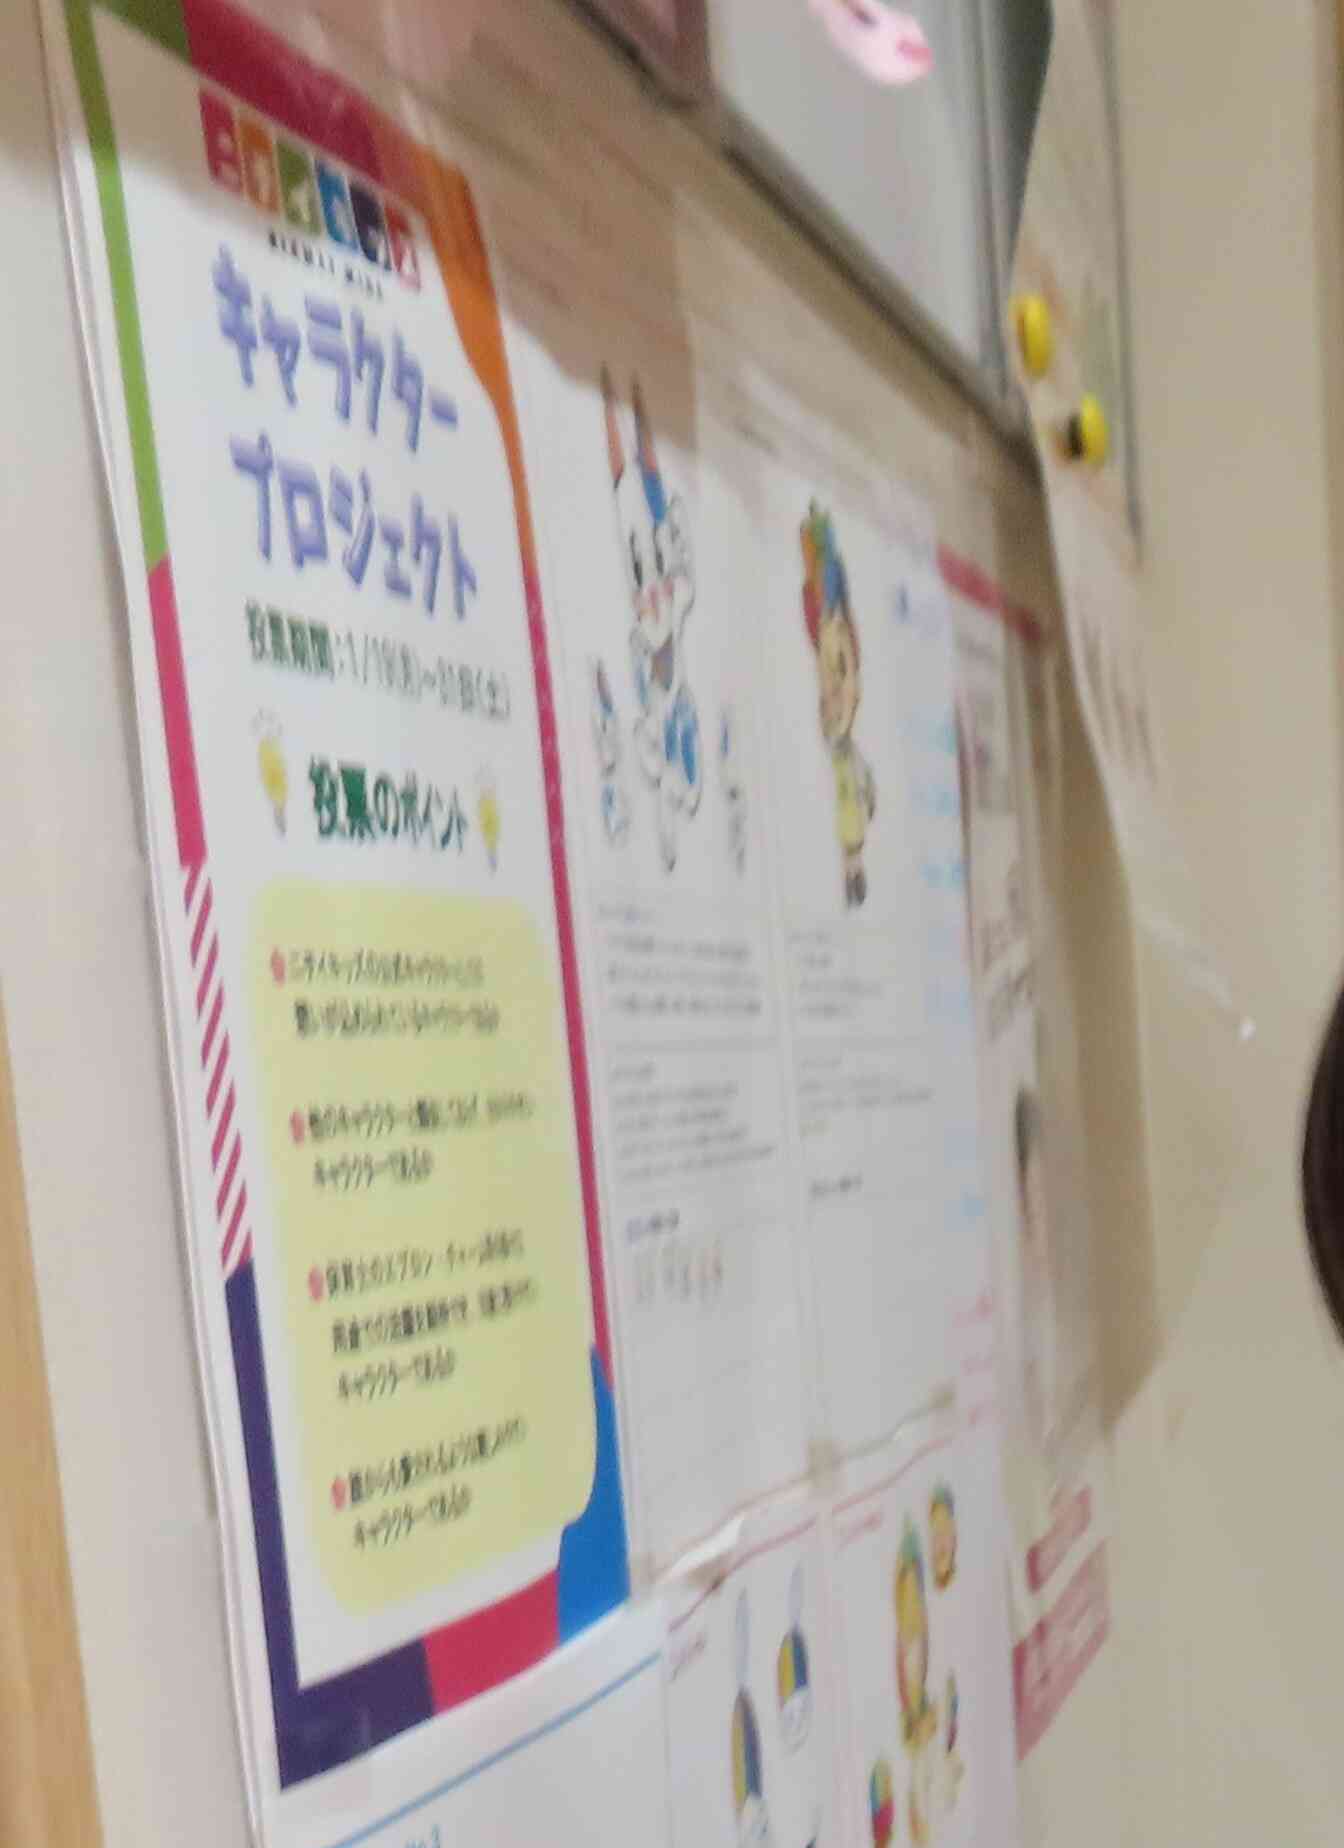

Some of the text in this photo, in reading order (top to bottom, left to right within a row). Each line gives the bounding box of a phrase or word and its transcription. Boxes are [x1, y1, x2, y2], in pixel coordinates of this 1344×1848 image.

[211, 242, 459, 453] キャラクター
[228, 430, 477, 622] プロジェクト
[309, 753, 468, 853] 投票のポイント
